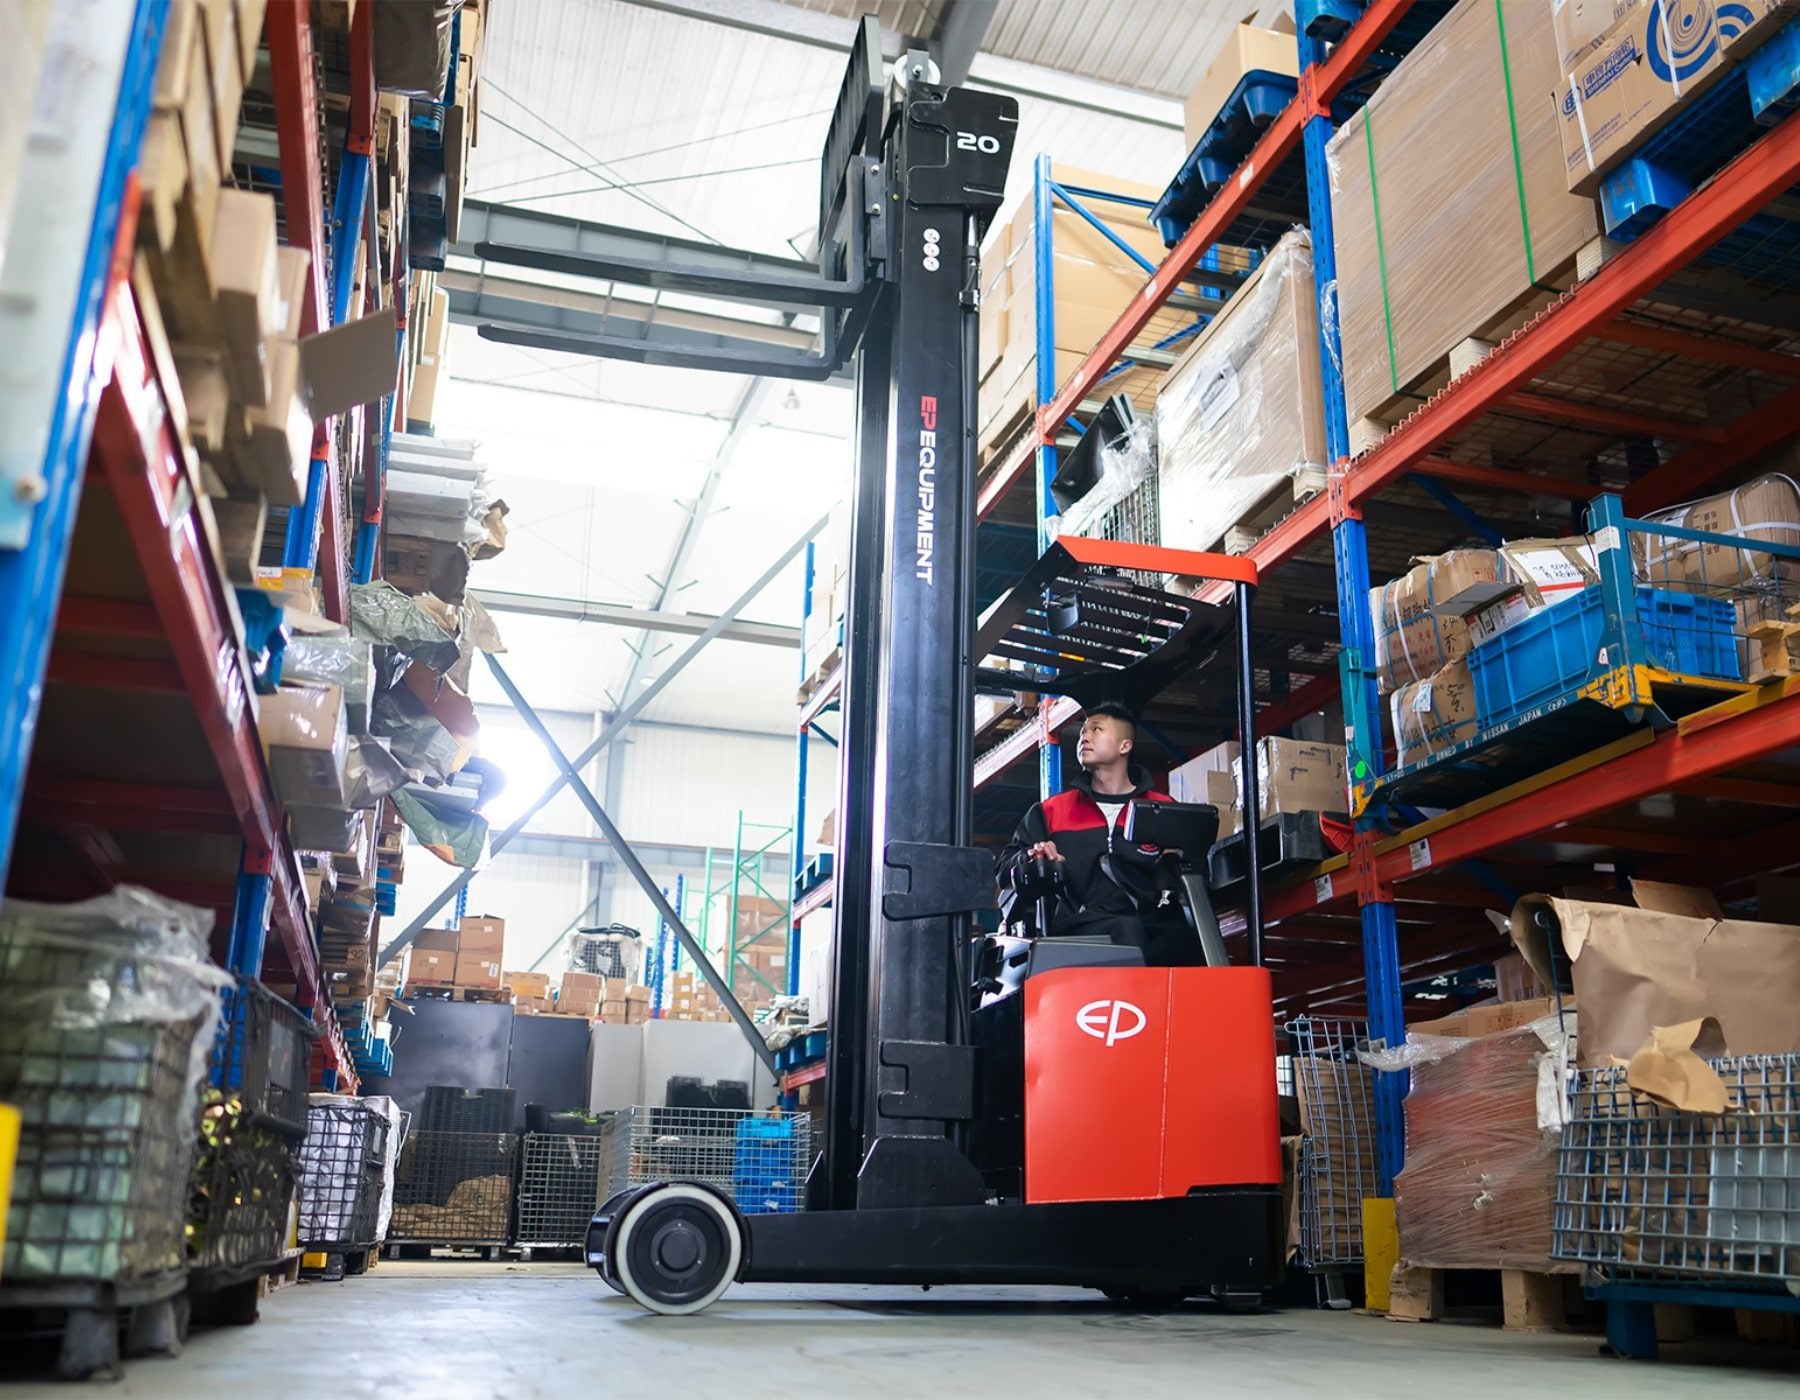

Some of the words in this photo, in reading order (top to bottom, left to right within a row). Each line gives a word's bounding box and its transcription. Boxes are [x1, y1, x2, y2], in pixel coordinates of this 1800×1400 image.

[957, 131, 1000, 154] 20
[1436, 744, 1458, 762] OWNED
[1464, 738, 1474, 750] BY
[1482, 721, 1509, 741] NISSAN
[1518, 706, 1542, 726] JAPAN
[1076, 1000, 1147, 1047] EP
